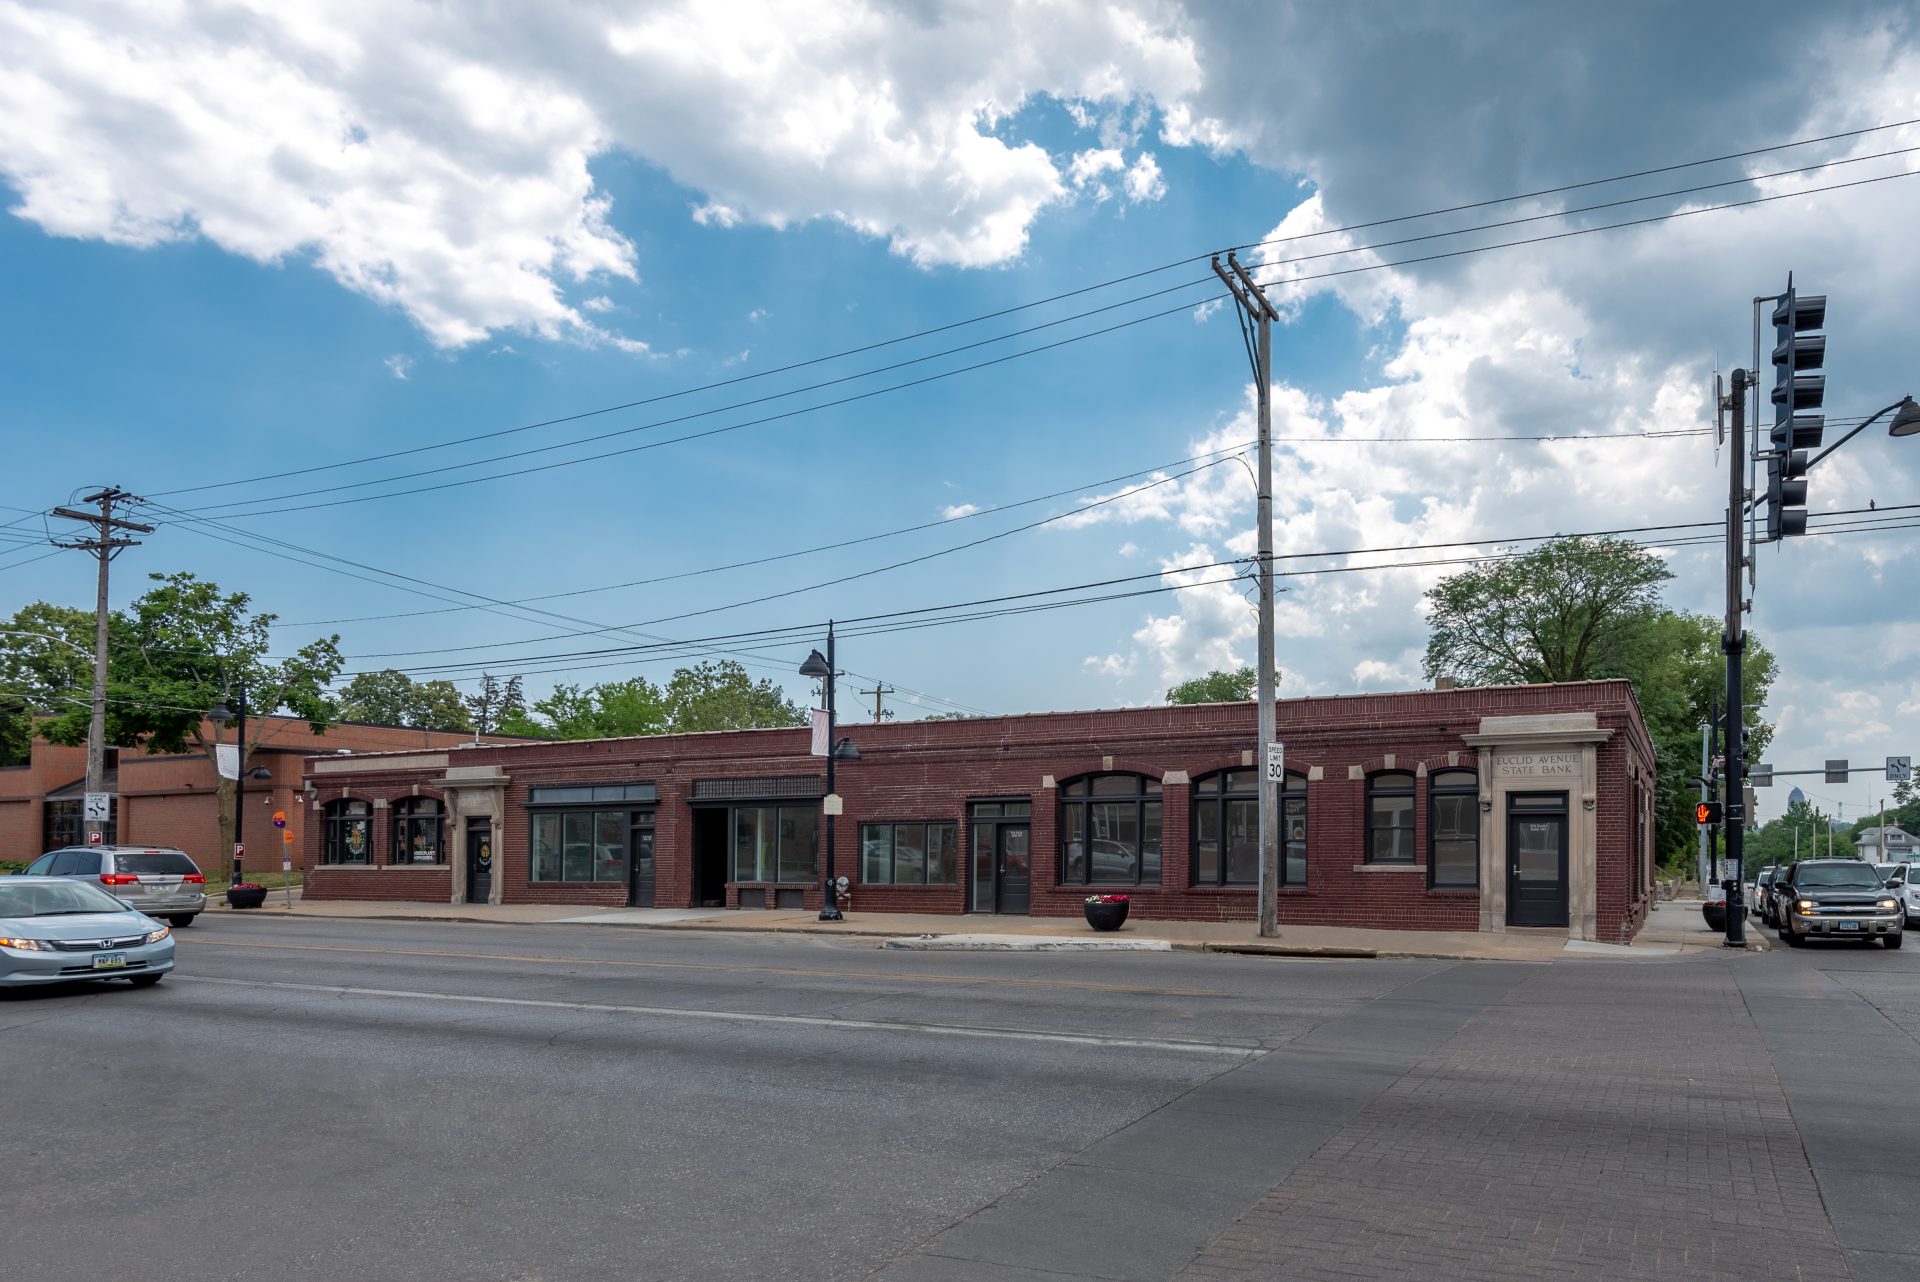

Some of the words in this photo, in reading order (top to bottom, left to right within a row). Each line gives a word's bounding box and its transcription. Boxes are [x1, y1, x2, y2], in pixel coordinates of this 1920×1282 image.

[1497, 756, 1533, 766] EUCLID
[1538, 754, 1579, 764] AVENUE
[1269, 763, 1281, 777] 30
[1502, 766, 1535, 775] STATE
[1542, 765, 1572, 774] BANK
[91, 833, 100, 842] P
[236, 845, 244, 854] P
